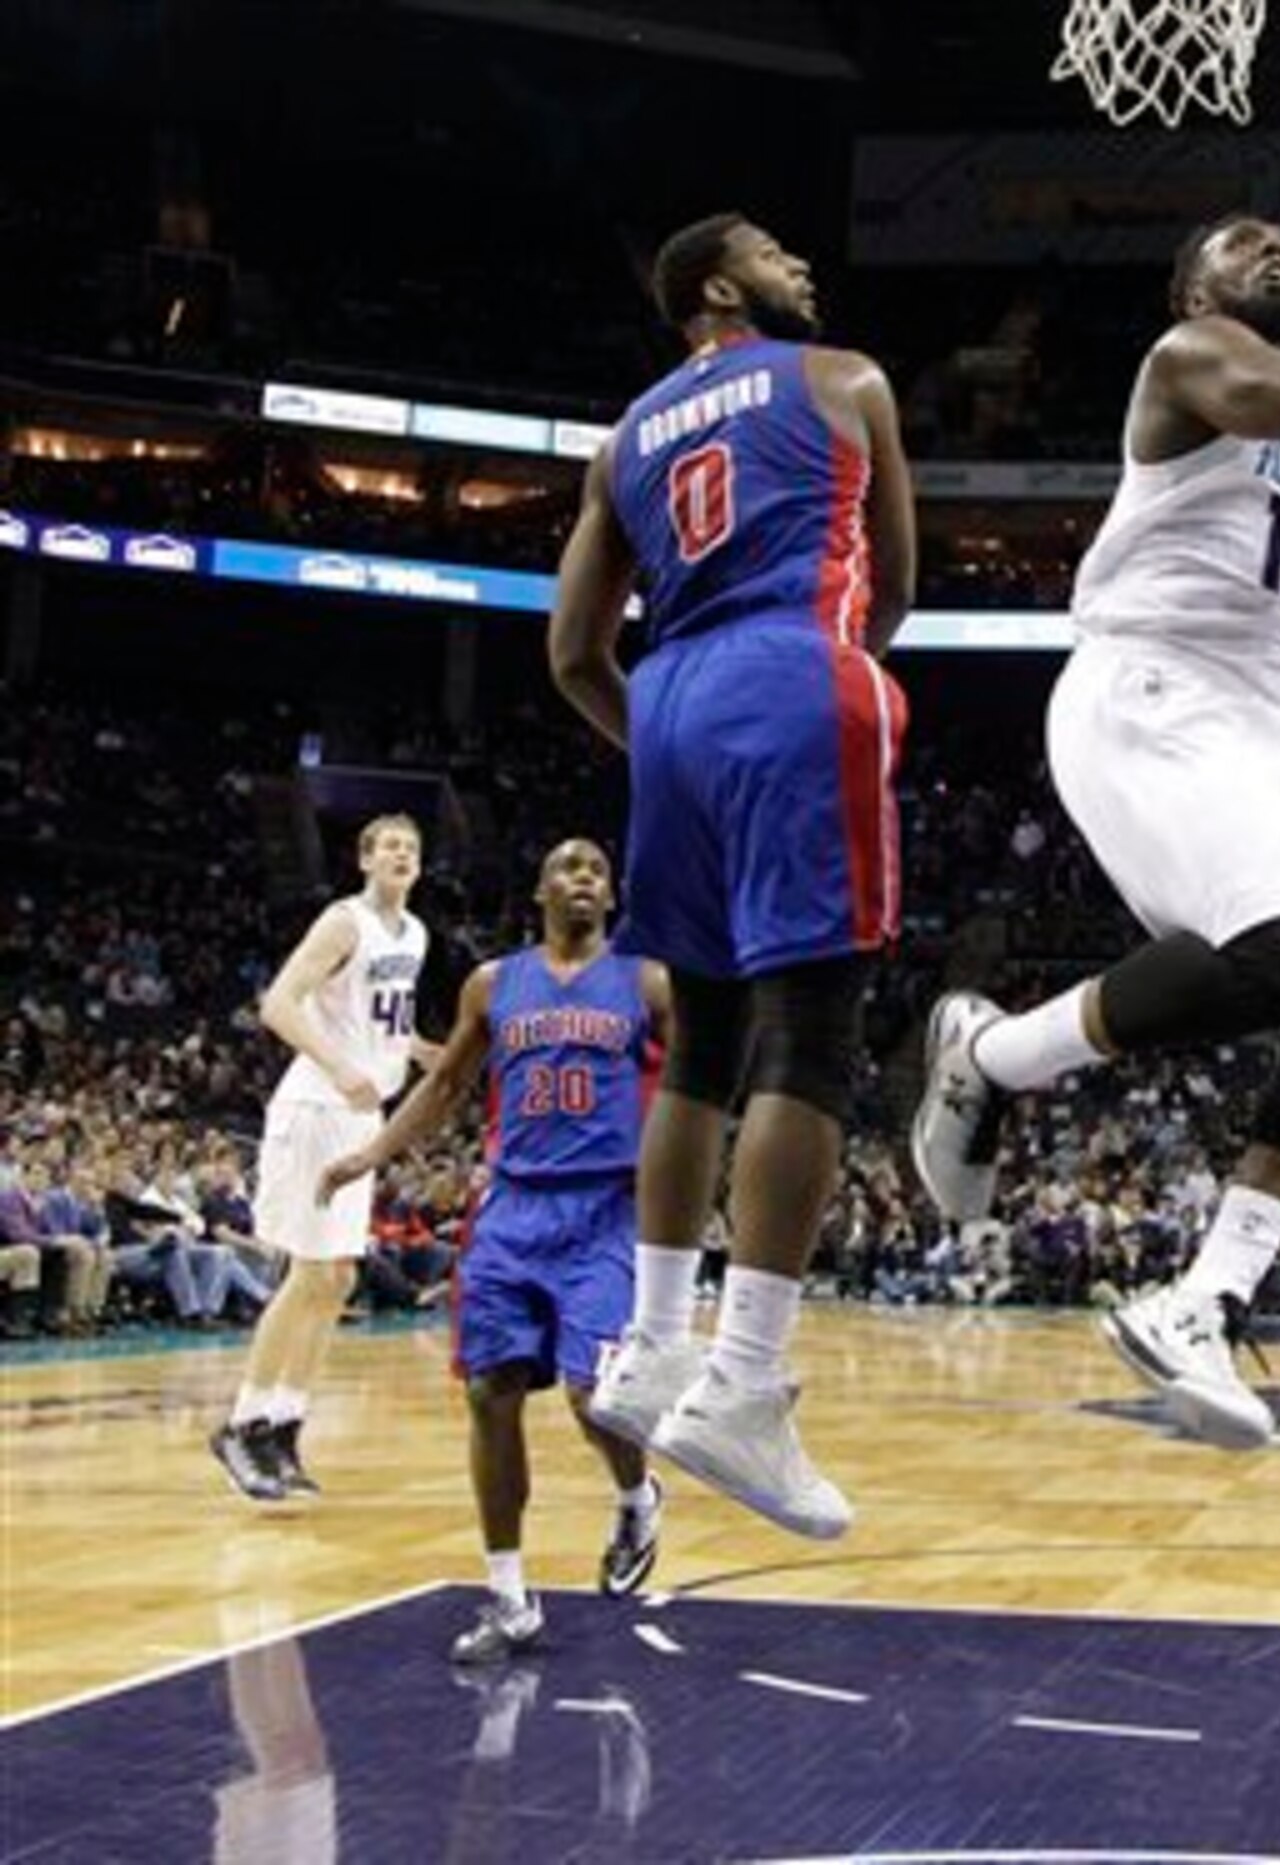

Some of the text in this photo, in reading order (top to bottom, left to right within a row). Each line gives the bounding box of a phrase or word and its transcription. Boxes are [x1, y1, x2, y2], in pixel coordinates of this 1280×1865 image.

[669, 442, 735, 563] 0
[502, 1007, 632, 1050] DETROIT
[522, 1063, 594, 1116] 20
